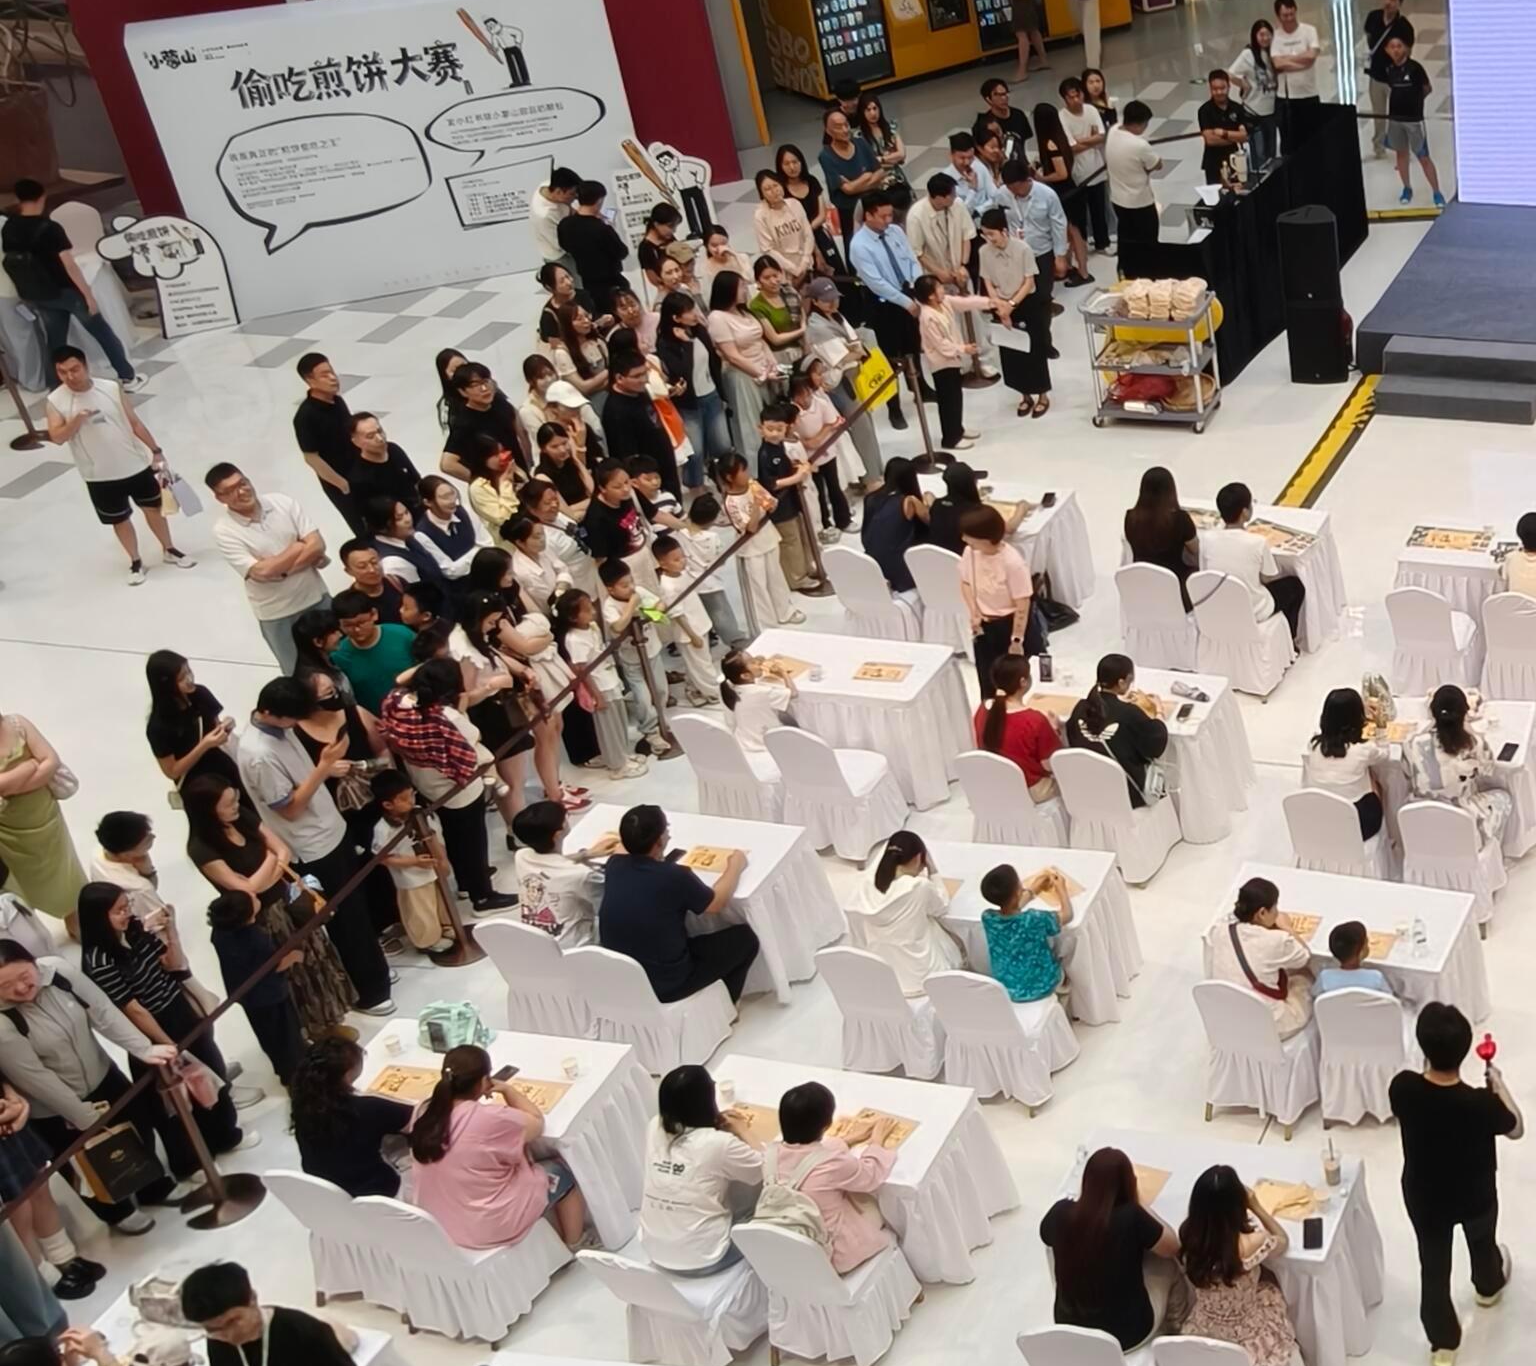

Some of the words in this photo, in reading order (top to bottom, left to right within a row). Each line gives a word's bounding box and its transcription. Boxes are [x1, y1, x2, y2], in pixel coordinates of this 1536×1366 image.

[230, 39, 466, 110] 偷吃煎饼大赛
